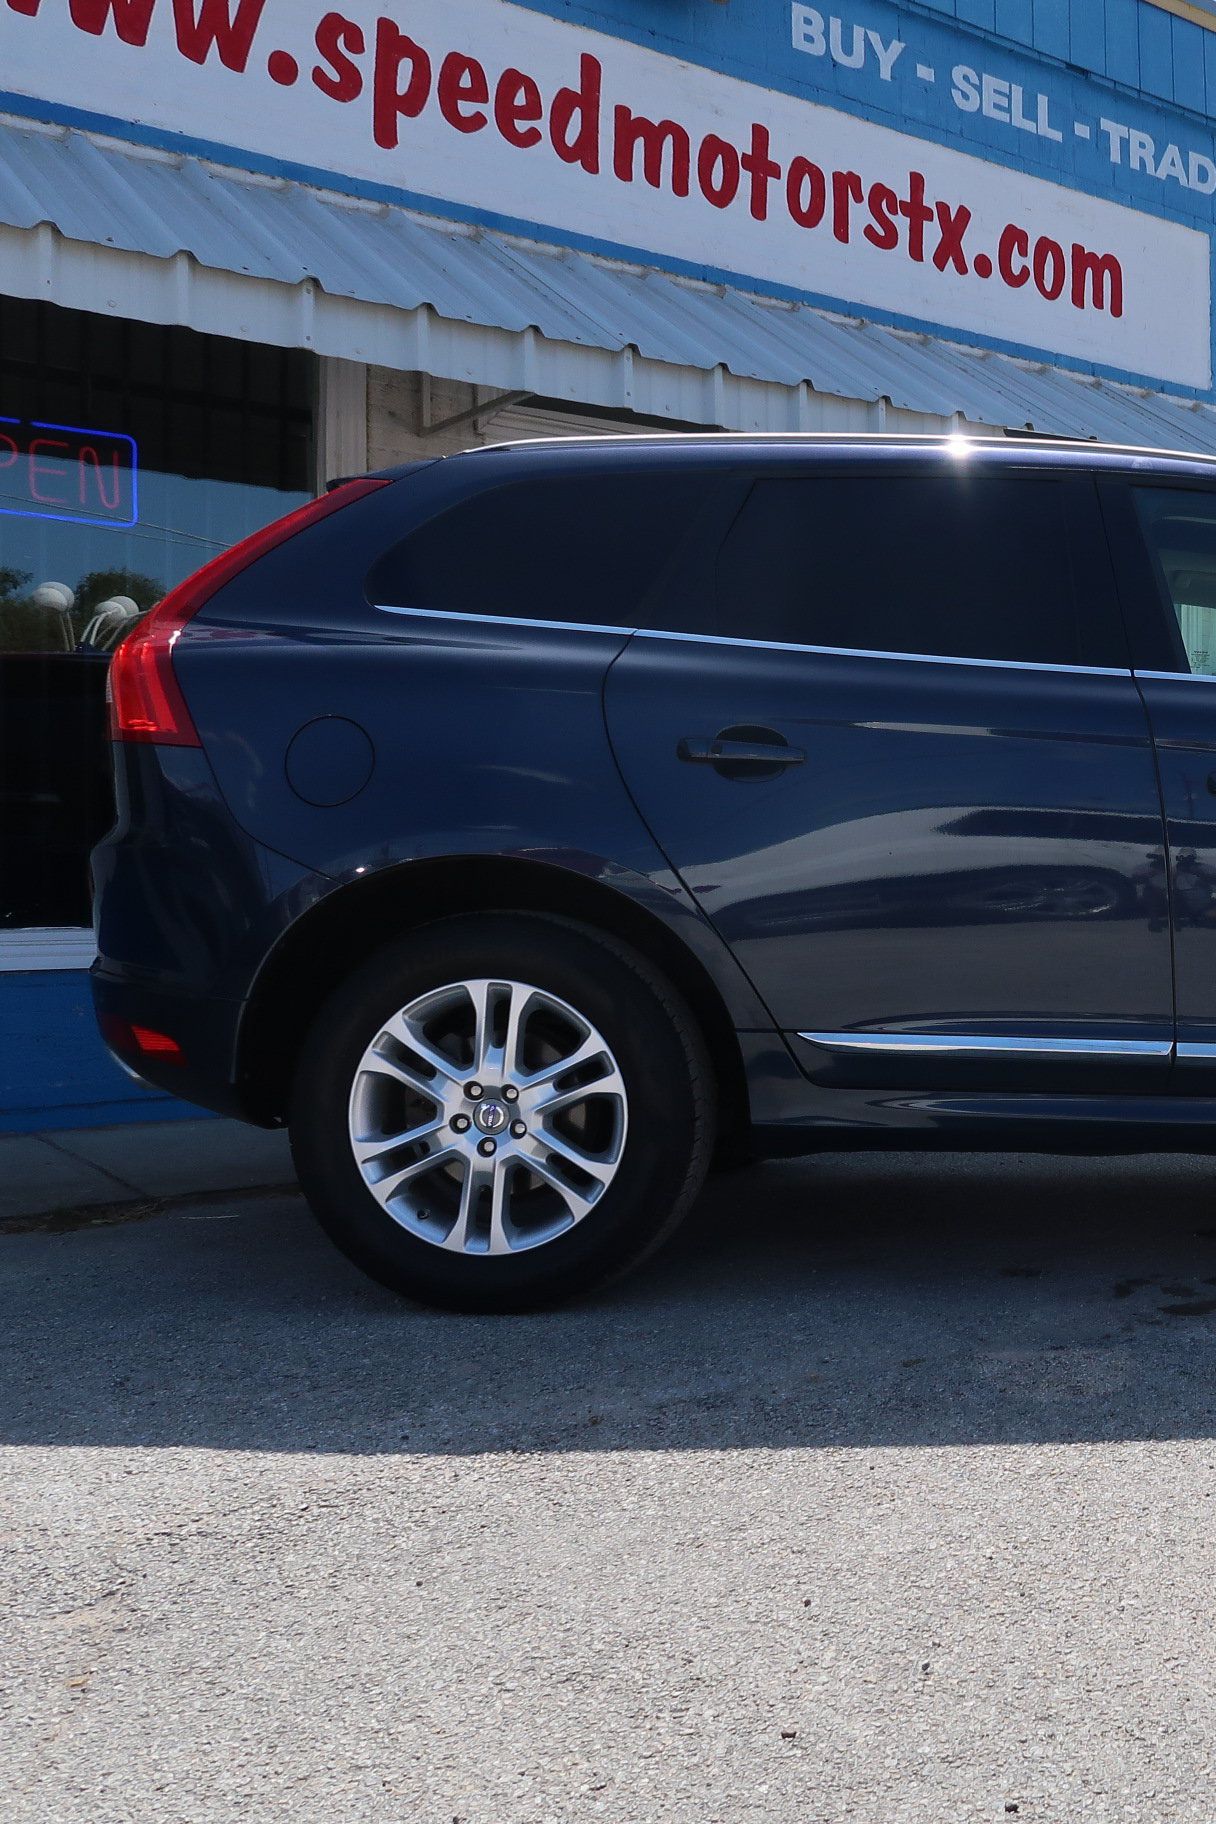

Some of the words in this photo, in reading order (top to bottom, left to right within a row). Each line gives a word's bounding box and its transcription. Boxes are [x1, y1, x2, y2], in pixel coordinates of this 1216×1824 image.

[6, 0, 1124, 318] w.speedmotorstx.com
[790, 1, 905, 82] BUY
[950, 64, 1063, 143] SELL
